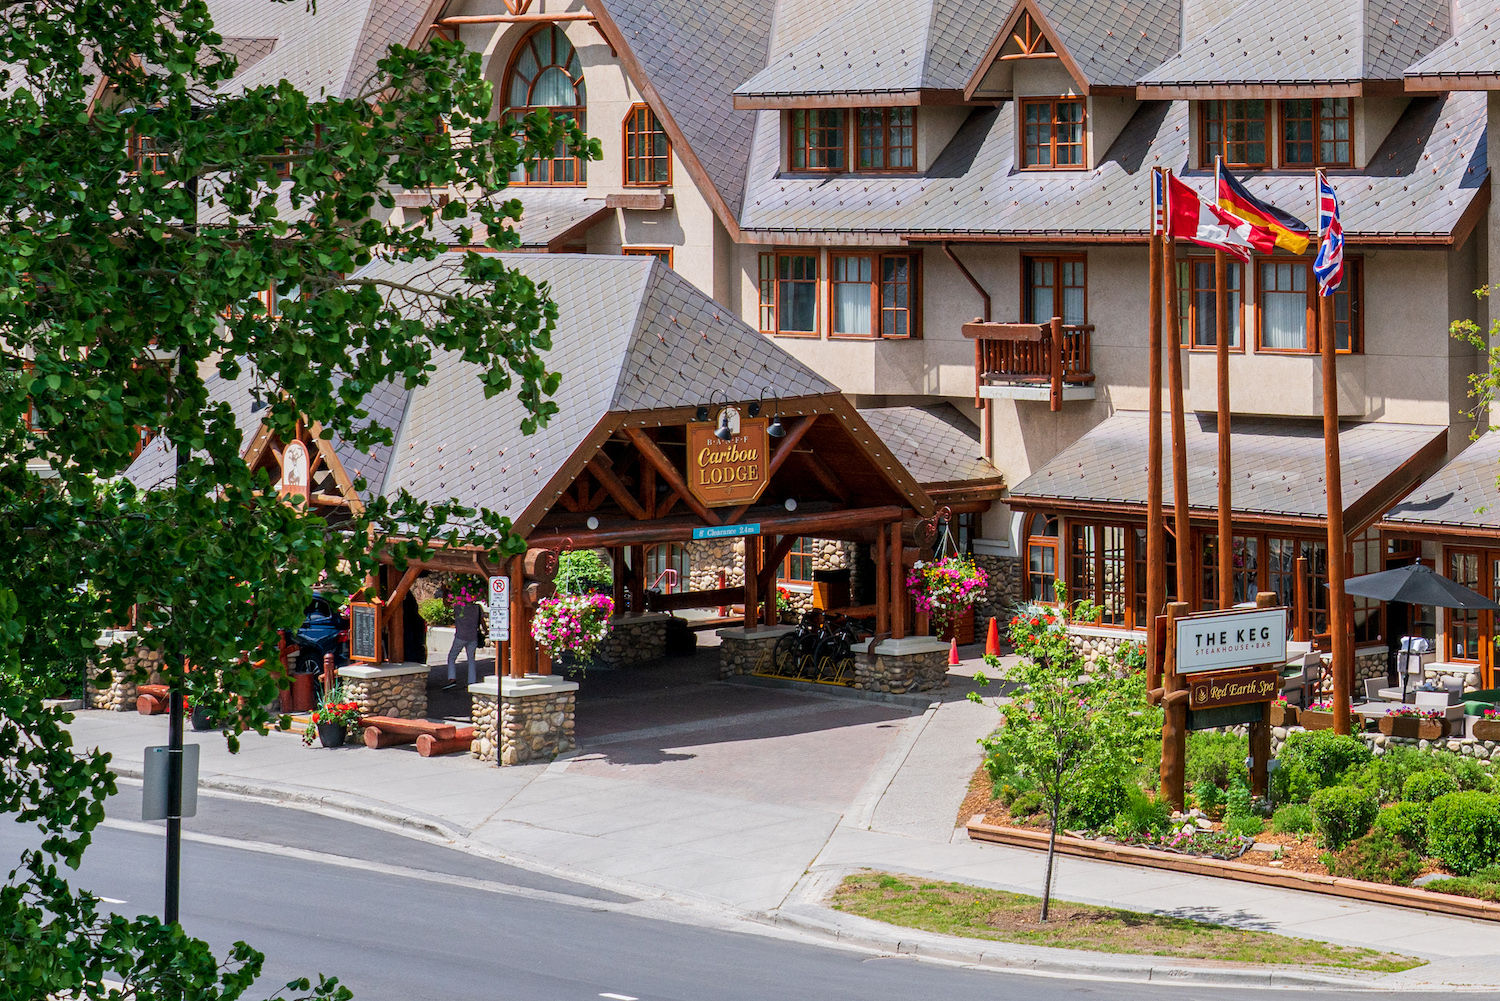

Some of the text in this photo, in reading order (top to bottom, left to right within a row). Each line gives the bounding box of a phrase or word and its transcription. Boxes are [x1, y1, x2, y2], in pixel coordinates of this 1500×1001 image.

[698, 444, 758, 467] Caribou
[699, 465, 759, 484] LODGE
[707, 528, 736, 536] Clearance
[1195, 626, 1269, 647] THE KEG
[1195, 643, 1249, 655] STEAKHOUSE
[1210, 679, 1274, 700] Red Earth Spa
